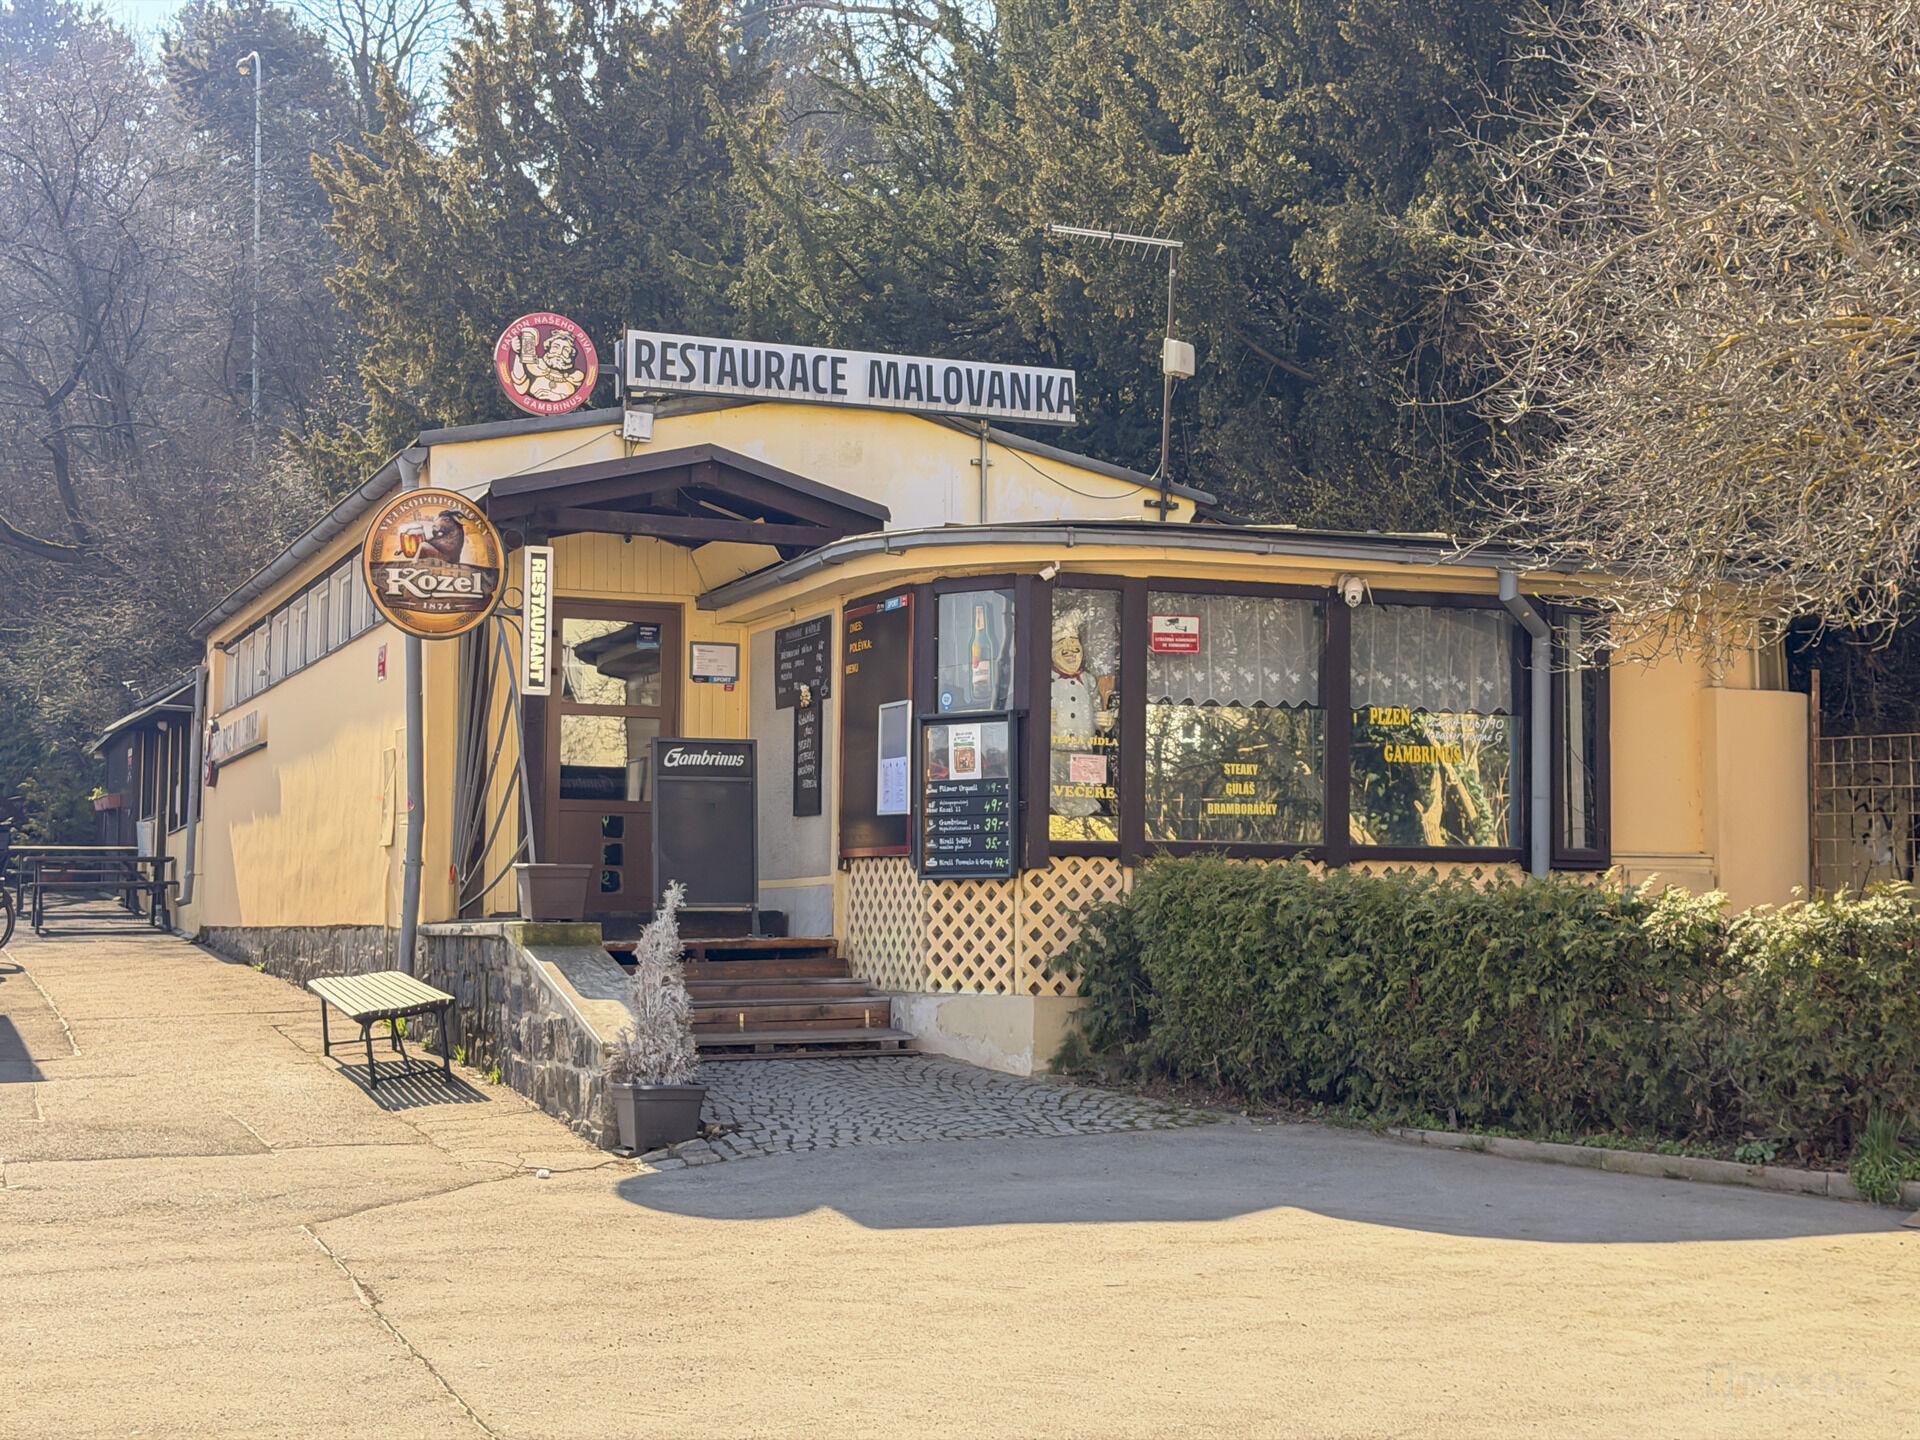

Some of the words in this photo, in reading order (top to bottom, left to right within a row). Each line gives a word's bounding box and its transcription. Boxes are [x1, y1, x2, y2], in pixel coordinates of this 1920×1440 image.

[501, 320, 531, 351] PATRON
[534, 316, 575, 333] NAŠEHO
[576, 332, 593, 353] PIVA
[634, 338, 848, 395] RESTAURACE
[868, 359, 1076, 414] MALOVANKA
[522, 397, 583, 412] GAMBRINUS
[384, 567, 483, 598] Kozel
[423, 602, 451, 610] 1874
[530, 557, 548, 683] RESTAURANT
[1369, 704, 1411, 726] PLZEŇ
[663, 747, 745, 767] Gambrinus
[1384, 745, 1461, 763] GAMBRINUS
[1224, 763, 1258, 775] STEAKY
[1053, 783, 1116, 798] VEČEŘE
